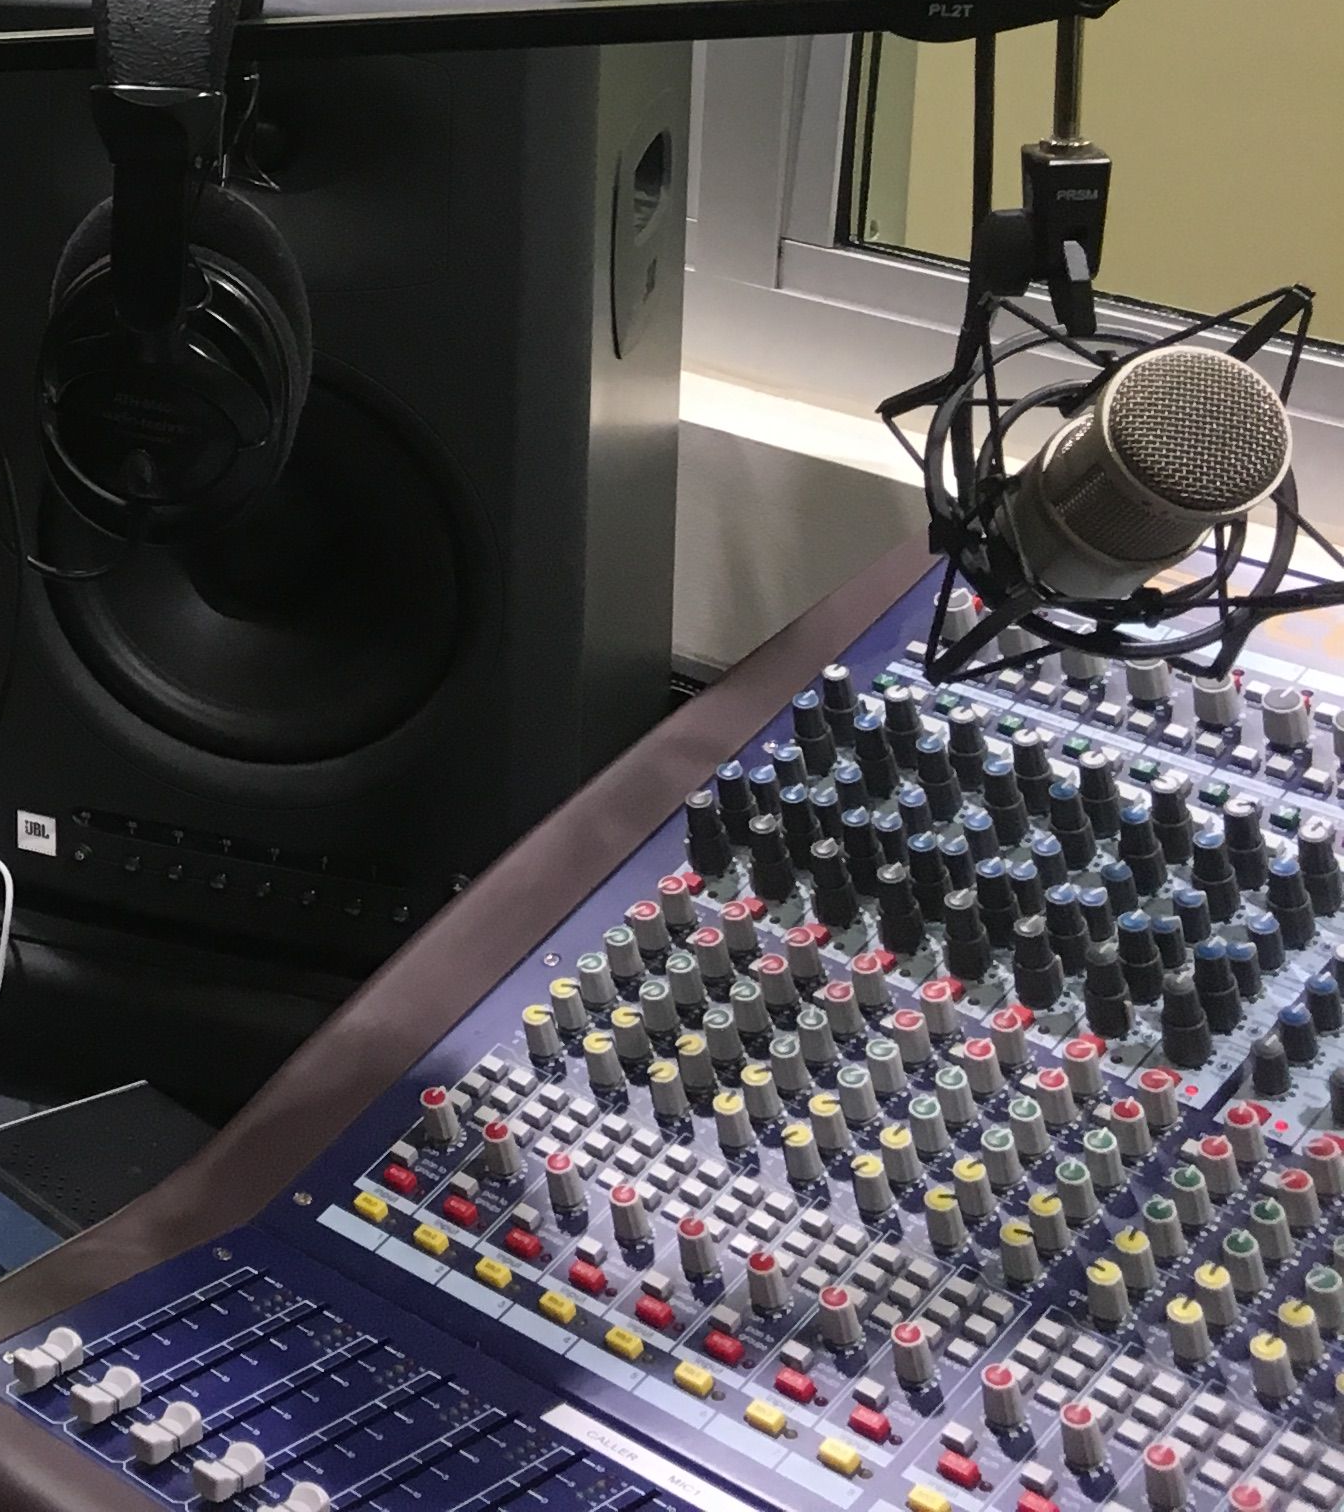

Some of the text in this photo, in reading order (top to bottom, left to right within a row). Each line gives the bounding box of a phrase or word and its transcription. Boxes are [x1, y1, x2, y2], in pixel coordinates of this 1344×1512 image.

[928, 3, 974, 18] PL2T
[24, 819, 50, 840] JBL
[585, 1429, 639, 1462] CALLER
[667, 1474, 703, 1496] MIC1
